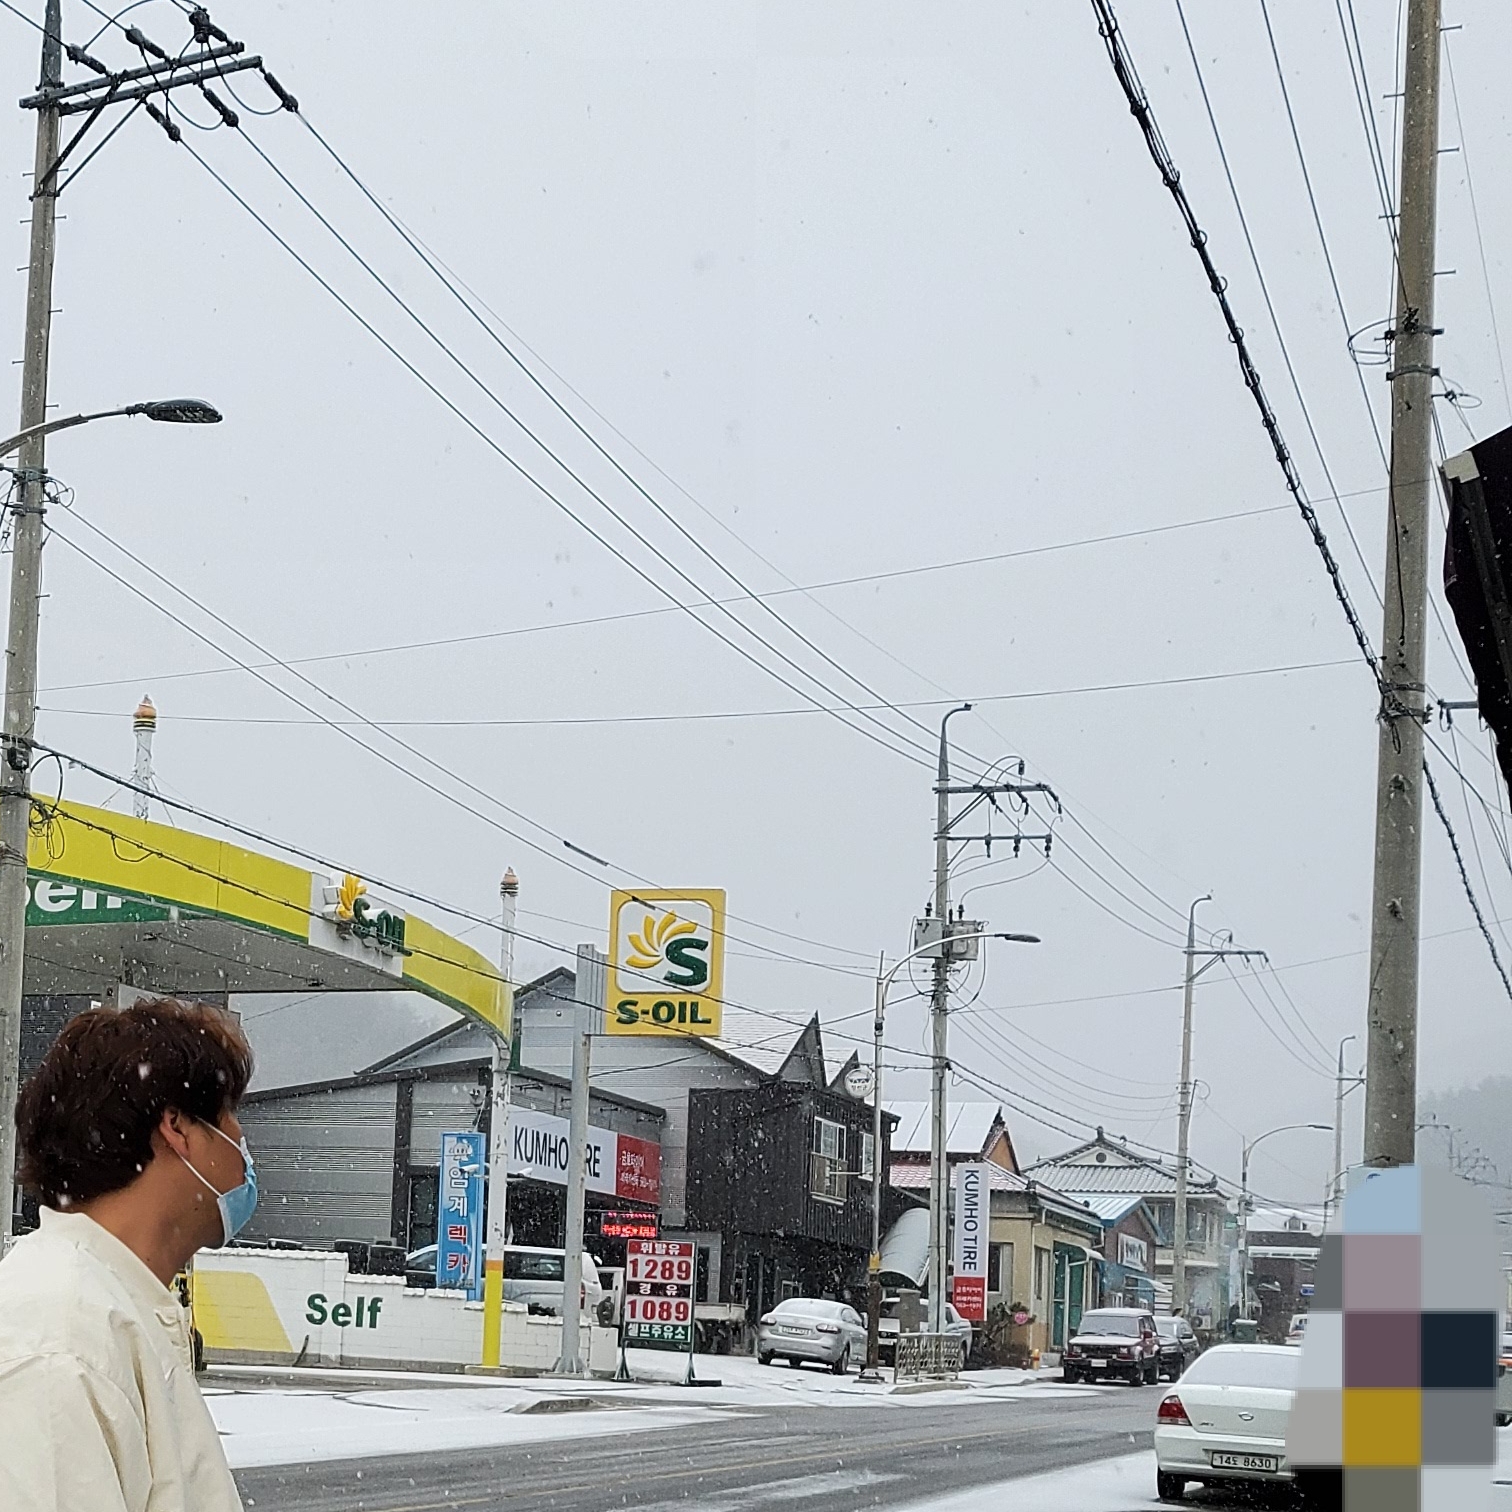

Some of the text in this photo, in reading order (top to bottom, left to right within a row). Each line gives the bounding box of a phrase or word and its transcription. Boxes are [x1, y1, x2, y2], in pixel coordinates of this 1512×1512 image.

[616, 999, 712, 1025] S-OIL
[513, 1124, 569, 1171] KUMHO
[962, 1169, 980, 1271] KUMHO TIRE
[640, 1242, 680, 1255] 휘발유
[629, 1257, 692, 1281] 1289
[305, 1293, 384, 1329] Self
[627, 1299, 689, 1321] 1089
[627, 1322, 686, 1340] 셀프주유소
